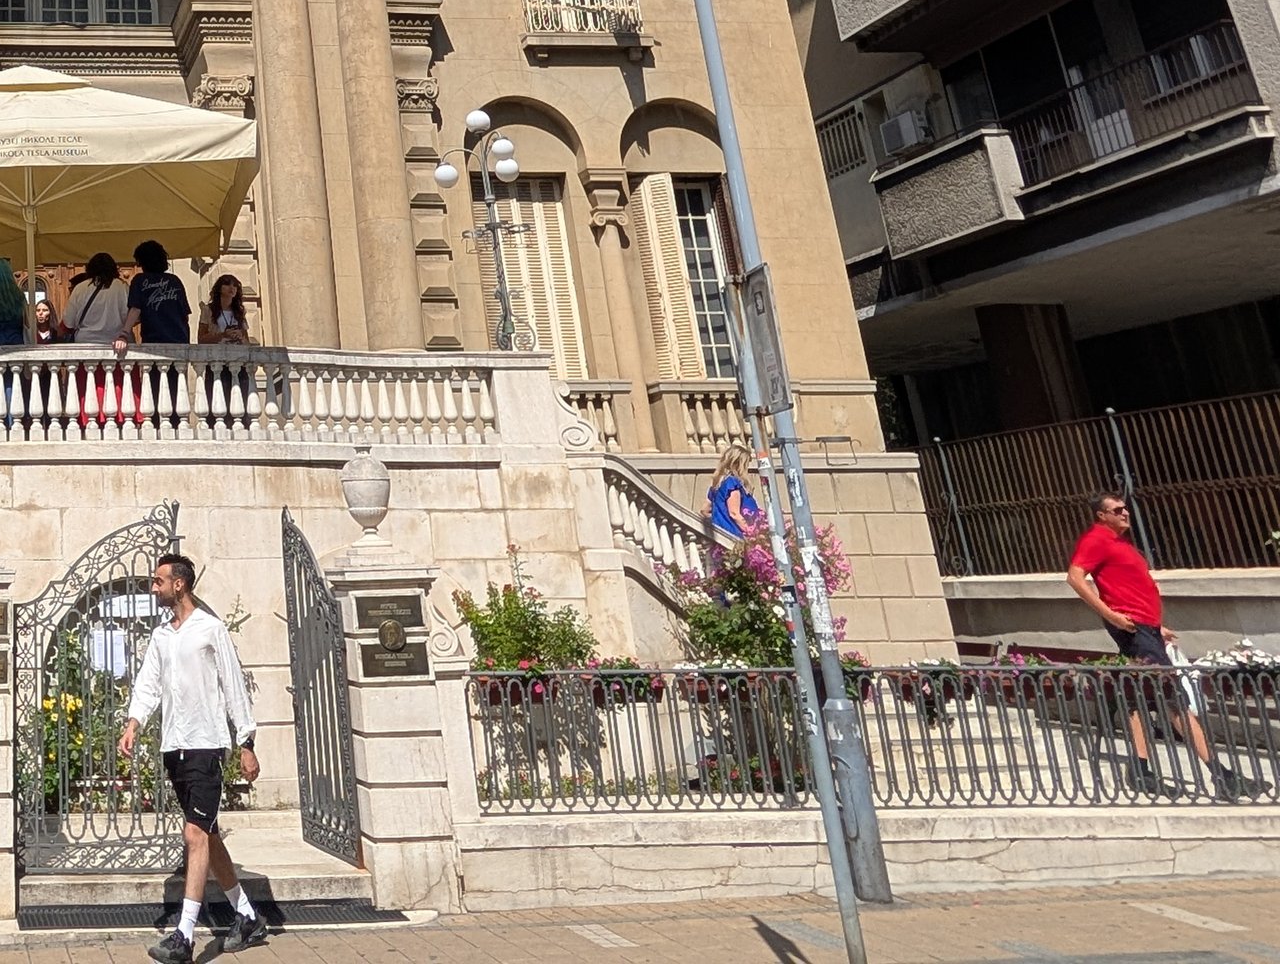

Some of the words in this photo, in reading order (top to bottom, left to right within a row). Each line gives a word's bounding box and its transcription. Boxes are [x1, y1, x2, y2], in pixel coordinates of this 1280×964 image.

[20, 136, 55, 144] НИКОЛЕ
[26, 149, 50, 157] TESLA
[52, 149, 89, 157] MUSEUM
